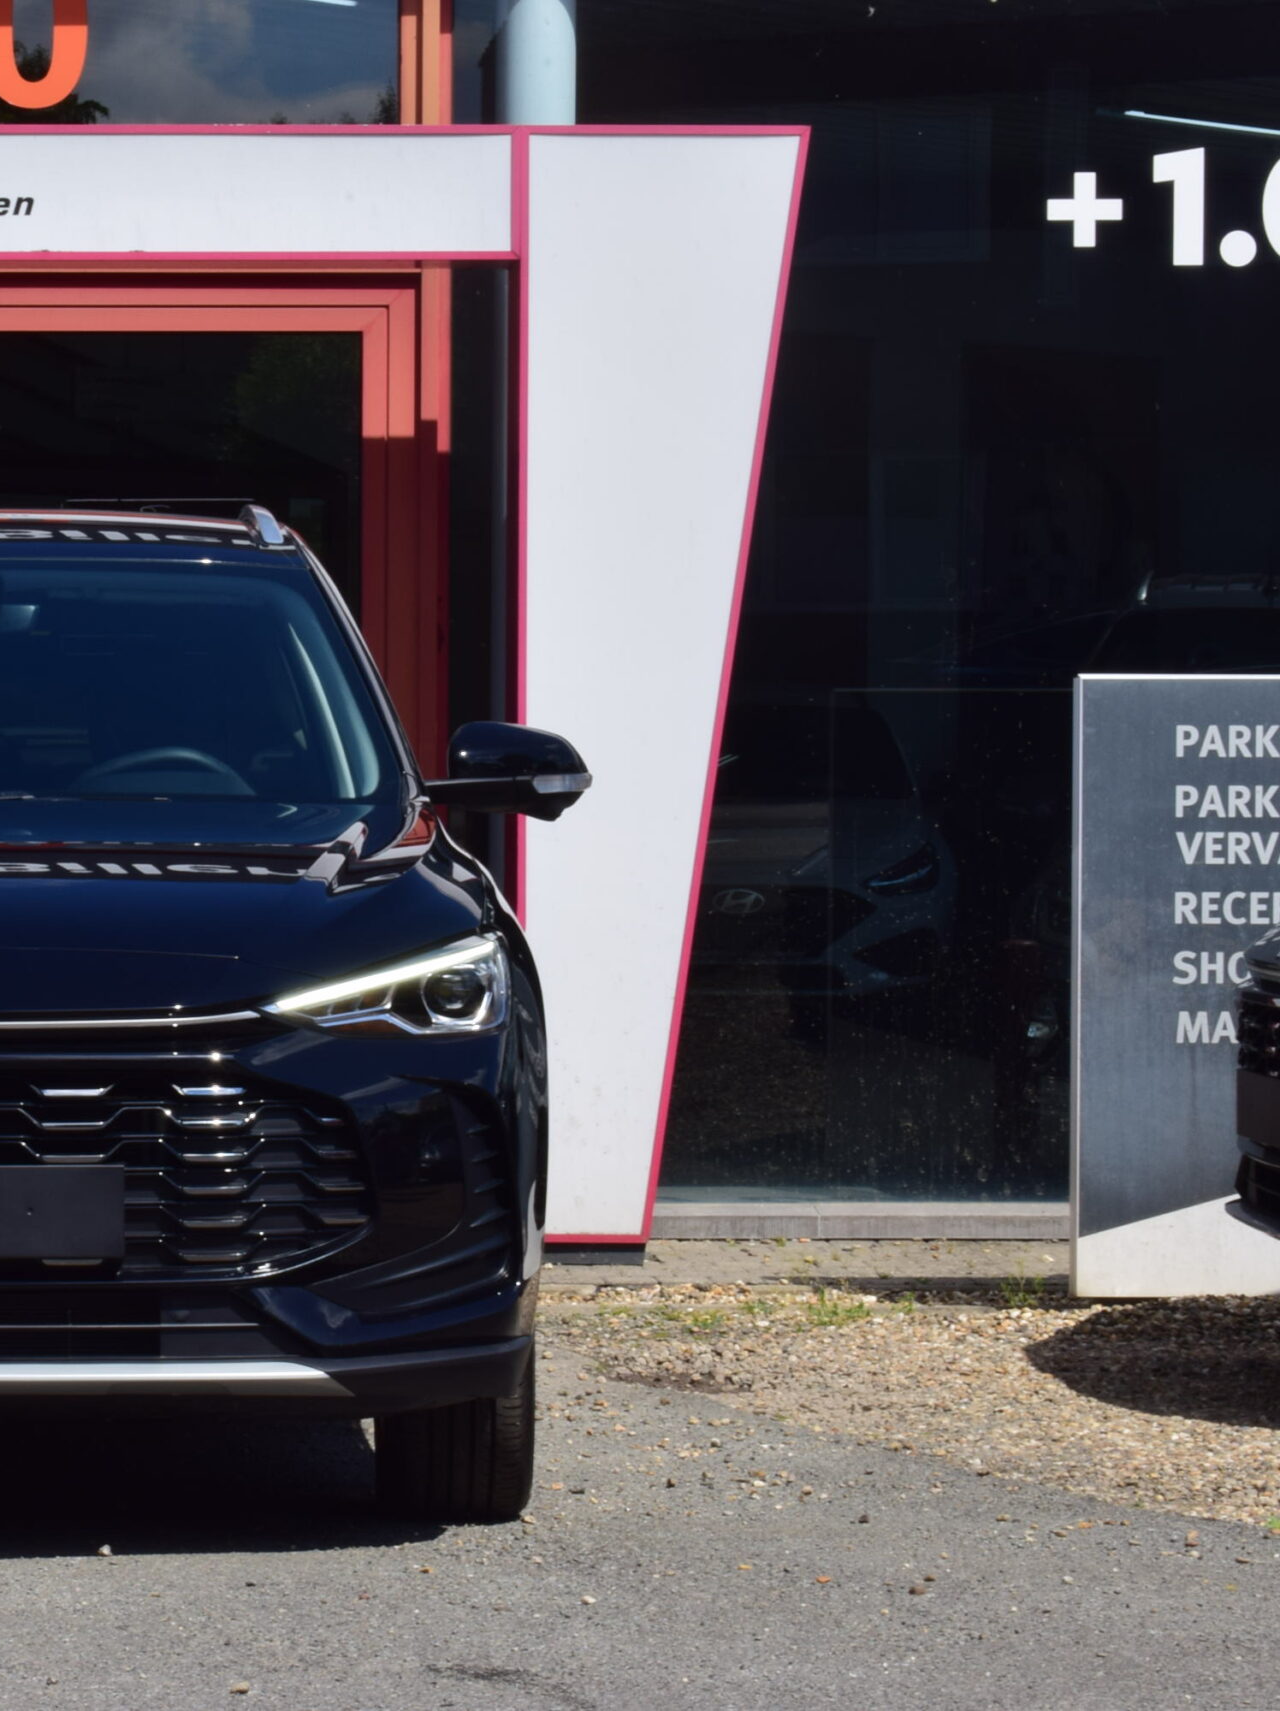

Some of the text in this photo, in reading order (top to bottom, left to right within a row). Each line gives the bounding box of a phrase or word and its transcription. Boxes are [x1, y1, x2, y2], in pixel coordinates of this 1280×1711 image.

[1153, 147, 1280, 267] 1.
[1176, 724, 1280, 758] PARK
[1175, 785, 1280, 818] PARK
[1175, 832, 1280, 865] VERV
